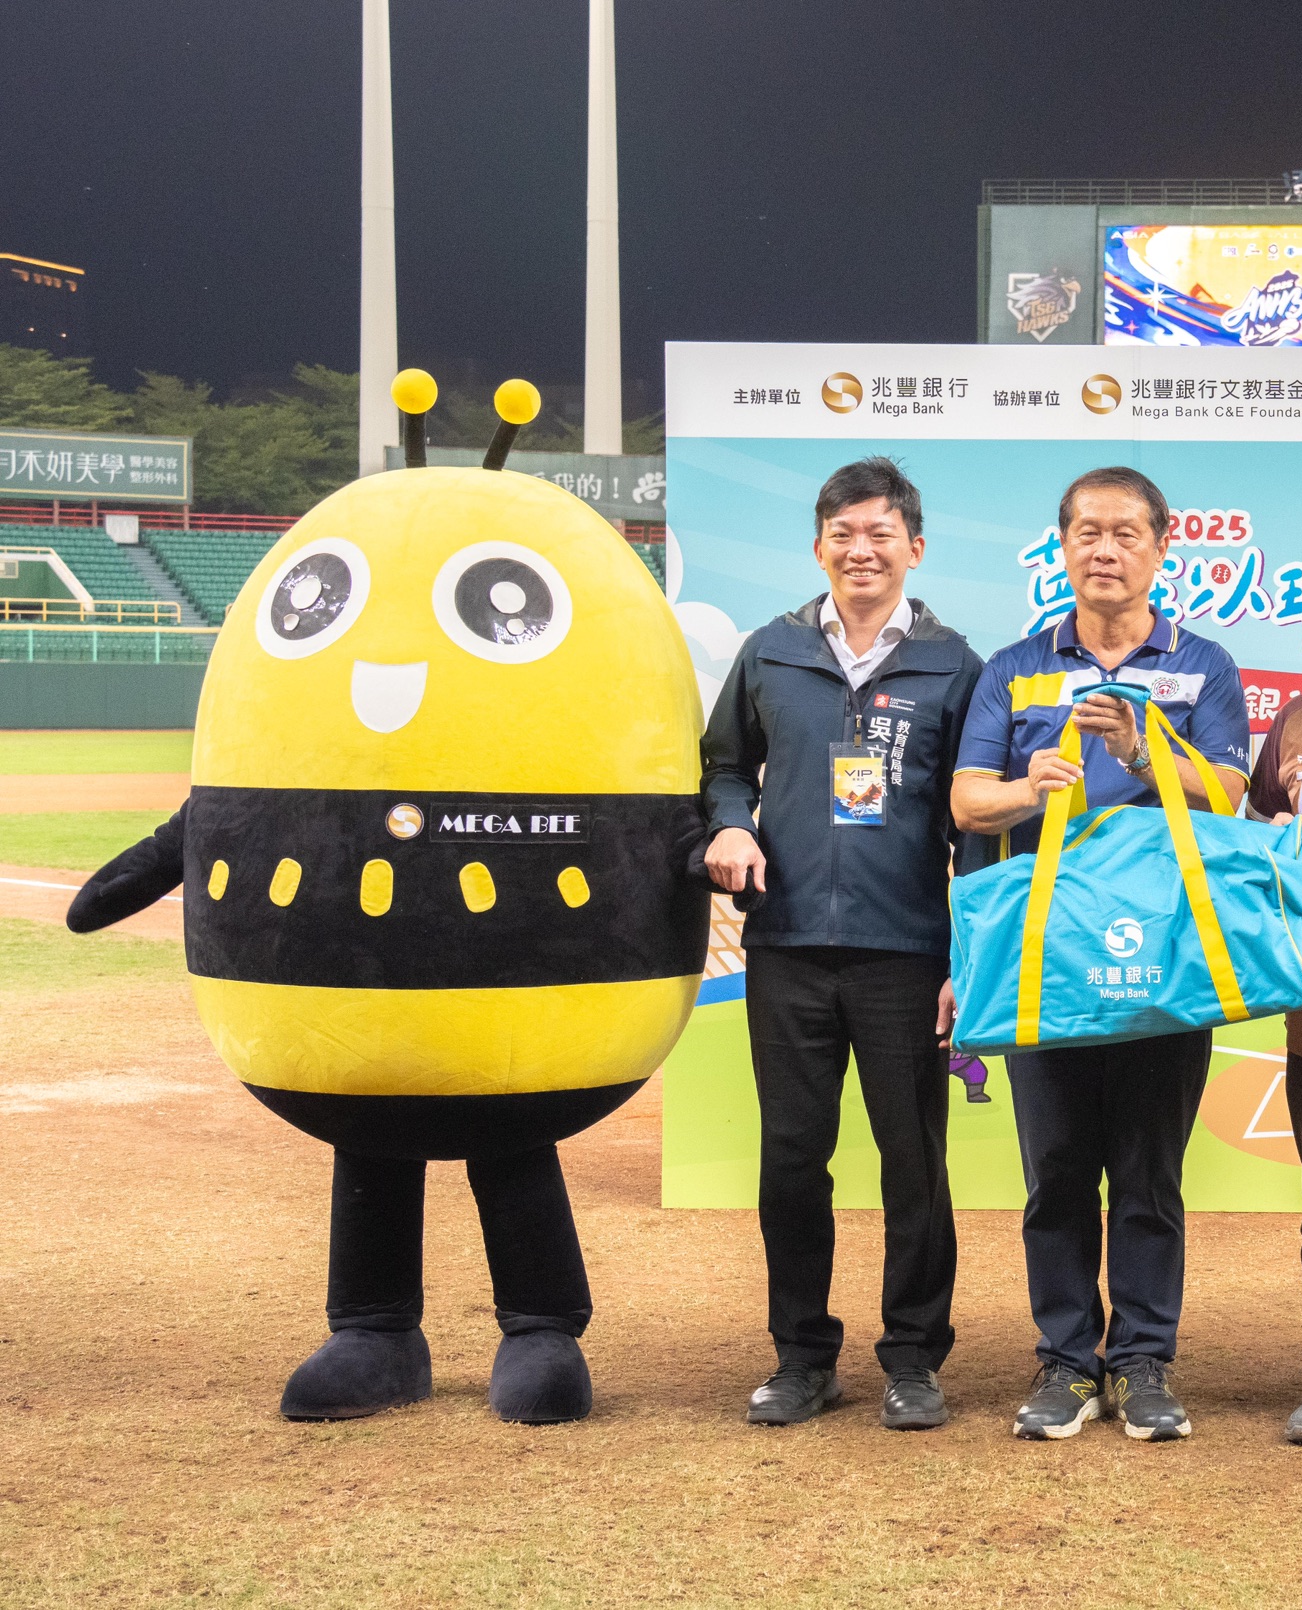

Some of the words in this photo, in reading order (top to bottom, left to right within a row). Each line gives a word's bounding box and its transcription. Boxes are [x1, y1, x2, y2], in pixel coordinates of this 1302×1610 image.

[1111, 231, 1150, 239] ASIA
[1017, 310, 1069, 334] HAWKS
[872, 377, 968, 398] 兆豐銀行
[733, 389, 801, 405] 主辦單位
[993, 390, 1060, 406] 協辦單位
[872, 402, 908, 417] Mega
[913, 402, 944, 414] Bank
[1132, 406, 1169, 420] Mega
[1175, 406, 1209, 417] Bank
[1215, 406, 1244, 417] C&E
[130, 455, 178, 470] 醫學美容
[130, 471, 178, 485] 整形外科
[1168, 515, 1248, 541] 2025
[890, 719, 911, 786] 教育局局長
[844, 769, 873, 777] VIP
[439, 814, 522, 833] MEGA
[531, 815, 581, 833] BEE
[1087, 965, 1163, 985] 兆豐銀行
[1100, 989, 1125, 1000] Mega
[1127, 988, 1149, 999] Bank
